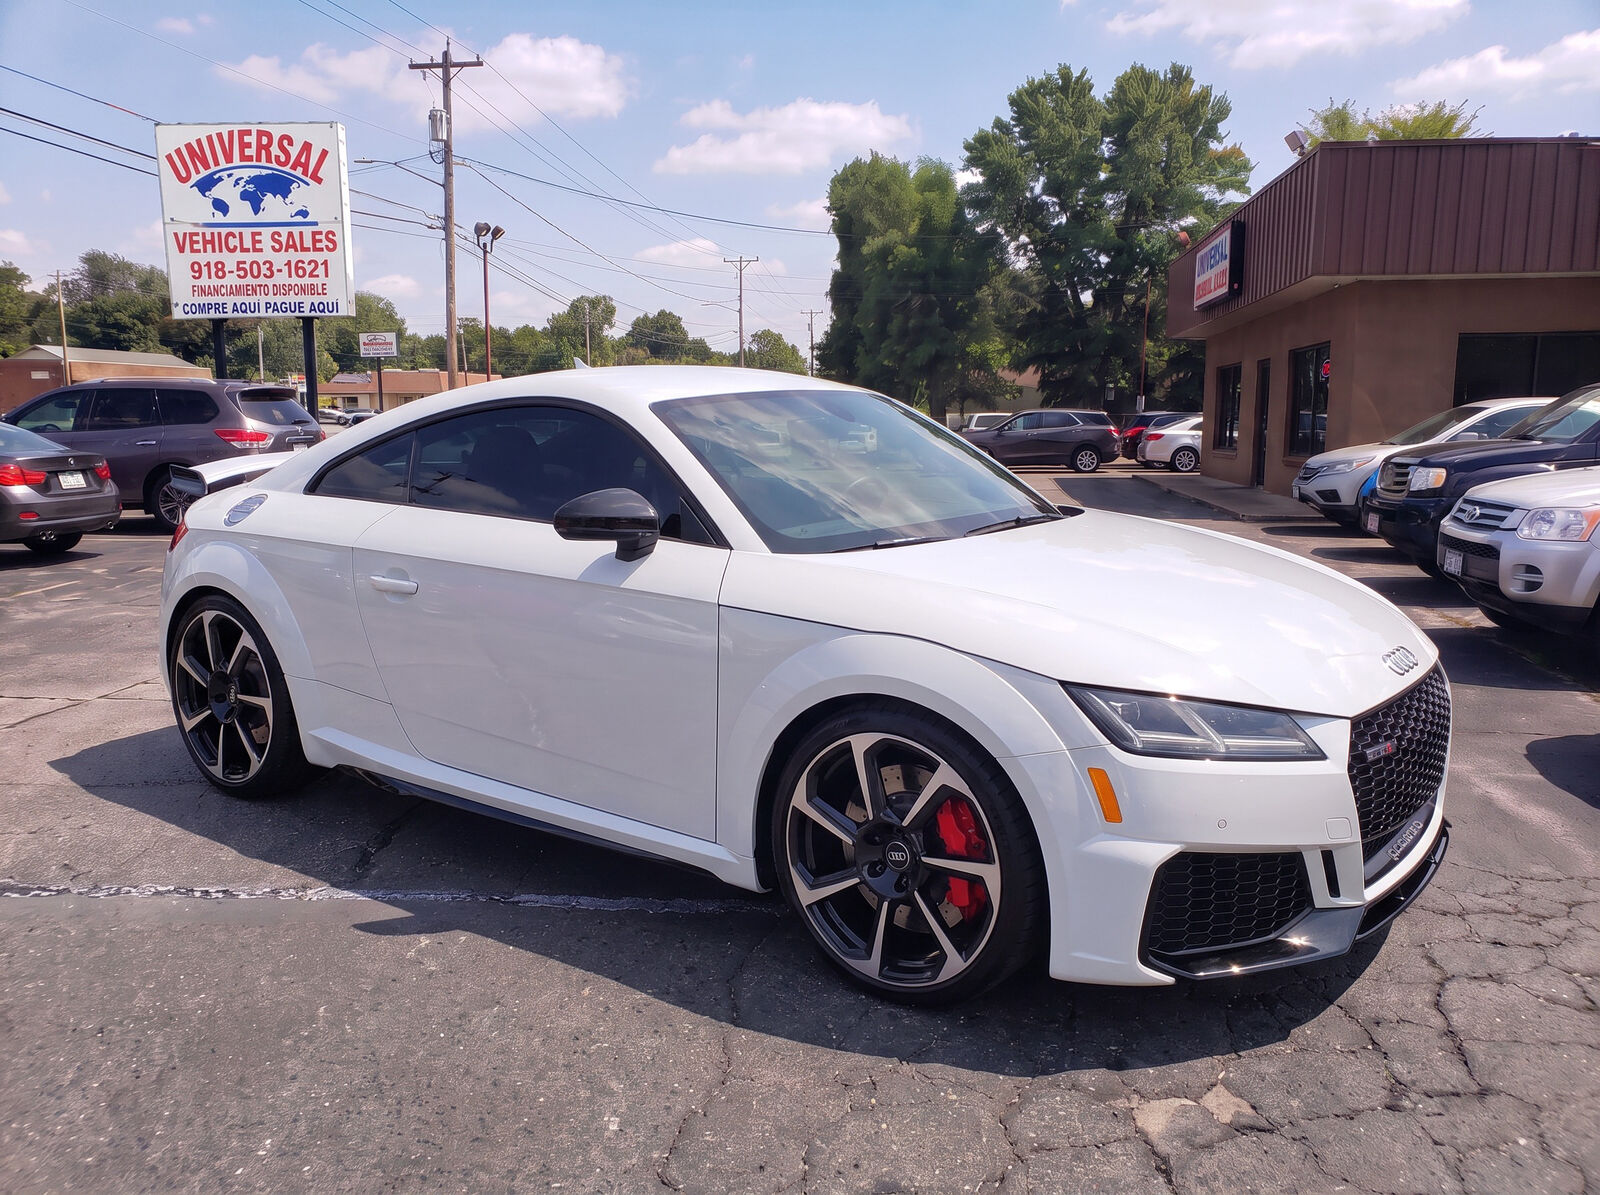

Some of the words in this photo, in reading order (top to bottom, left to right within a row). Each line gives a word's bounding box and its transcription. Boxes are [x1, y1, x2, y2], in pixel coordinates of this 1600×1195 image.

[165, 129, 329, 185] UNIVERSAL
[173, 231, 264, 254] VEHICLE
[270, 230, 338, 253] SALES
[190, 259, 329, 280] 918-503-1621
[191, 284, 269, 297] FINANCIAMIENTO
[273, 283, 328, 296] DISPONIBLE
[182, 302, 228, 315] COMPRE
[265, 301, 305, 314] PAGUE
